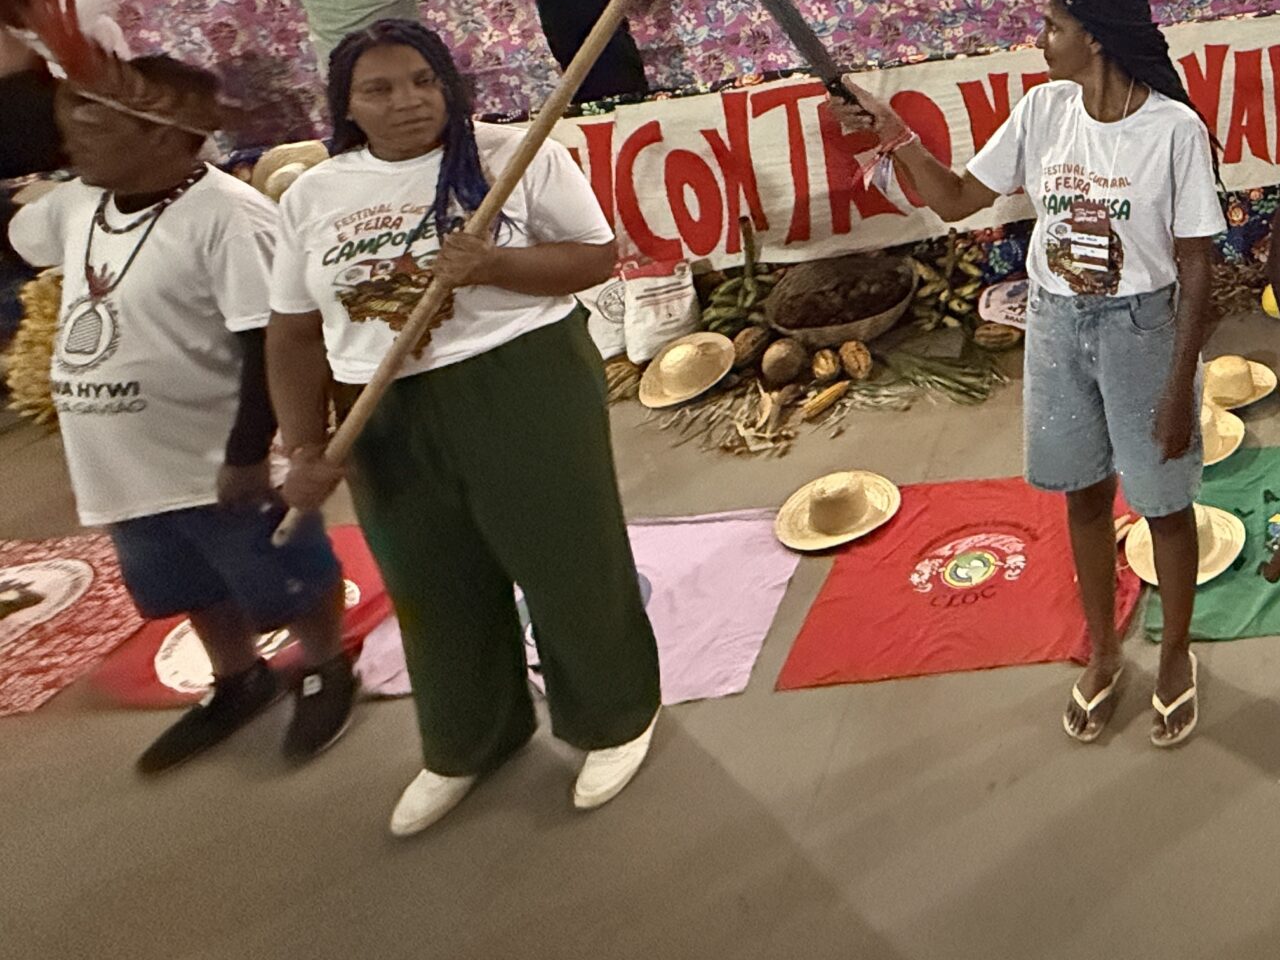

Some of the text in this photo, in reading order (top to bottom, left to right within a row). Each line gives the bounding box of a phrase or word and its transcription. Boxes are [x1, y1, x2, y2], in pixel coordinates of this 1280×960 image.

[1055, 175, 1092, 195] FEIRA
[334, 202, 394, 229] FESTIVAL
[354, 214, 404, 235] FEIRA
